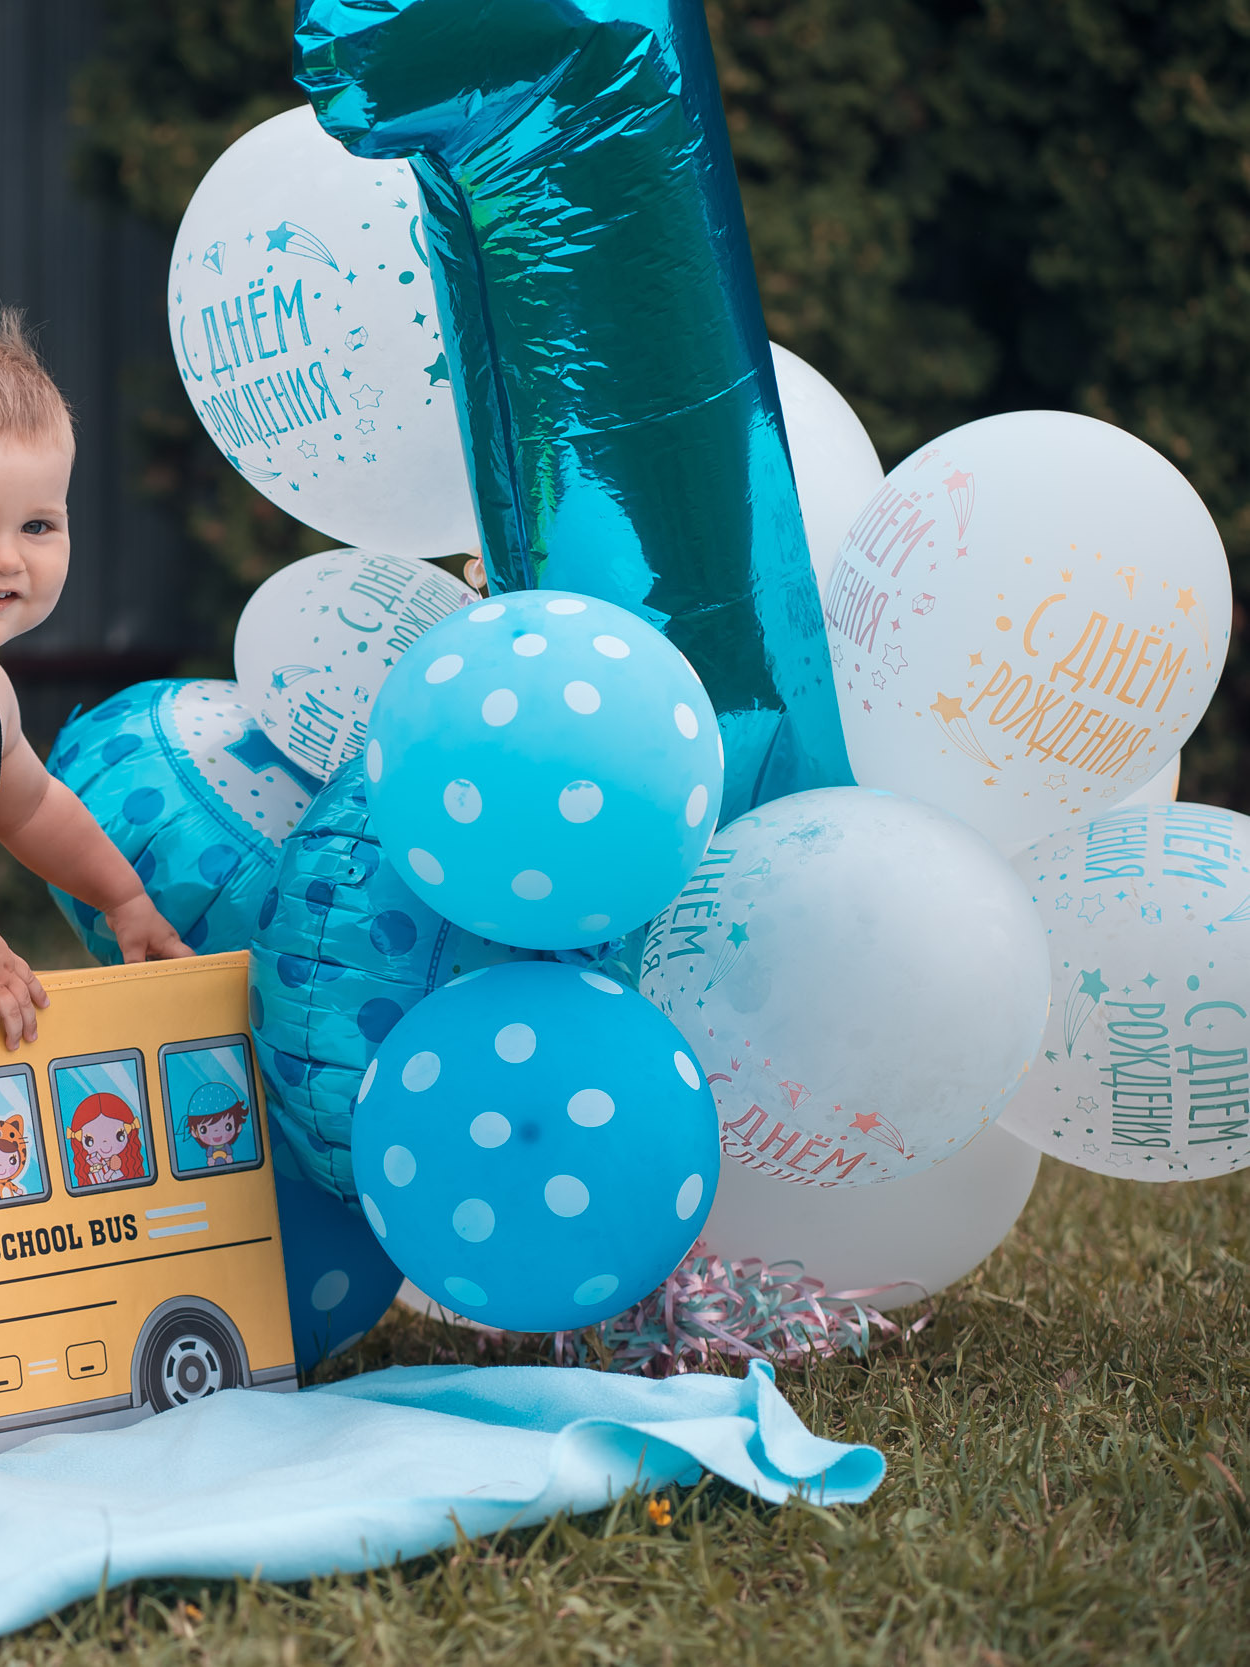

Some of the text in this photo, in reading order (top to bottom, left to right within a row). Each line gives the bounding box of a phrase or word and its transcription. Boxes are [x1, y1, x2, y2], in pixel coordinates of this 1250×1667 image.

[201, 278, 312, 387] ДНЁМ
[201, 361, 342, 452] РОЖДЕНИЯ
[824, 556, 889, 654] ДЕНИЯ
[1023, 593, 1189, 713] С ДНЁМ
[968, 660, 1151, 779] РОЖДЕНИЯ
[1077, 810, 1148, 884] ДЕНИЯ
[1099, 1000, 1173, 1148] РОЖДЕНИЯ
[721, 1103, 868, 1180] ДНЁМ
[91, 1213, 139, 1247] BUS
